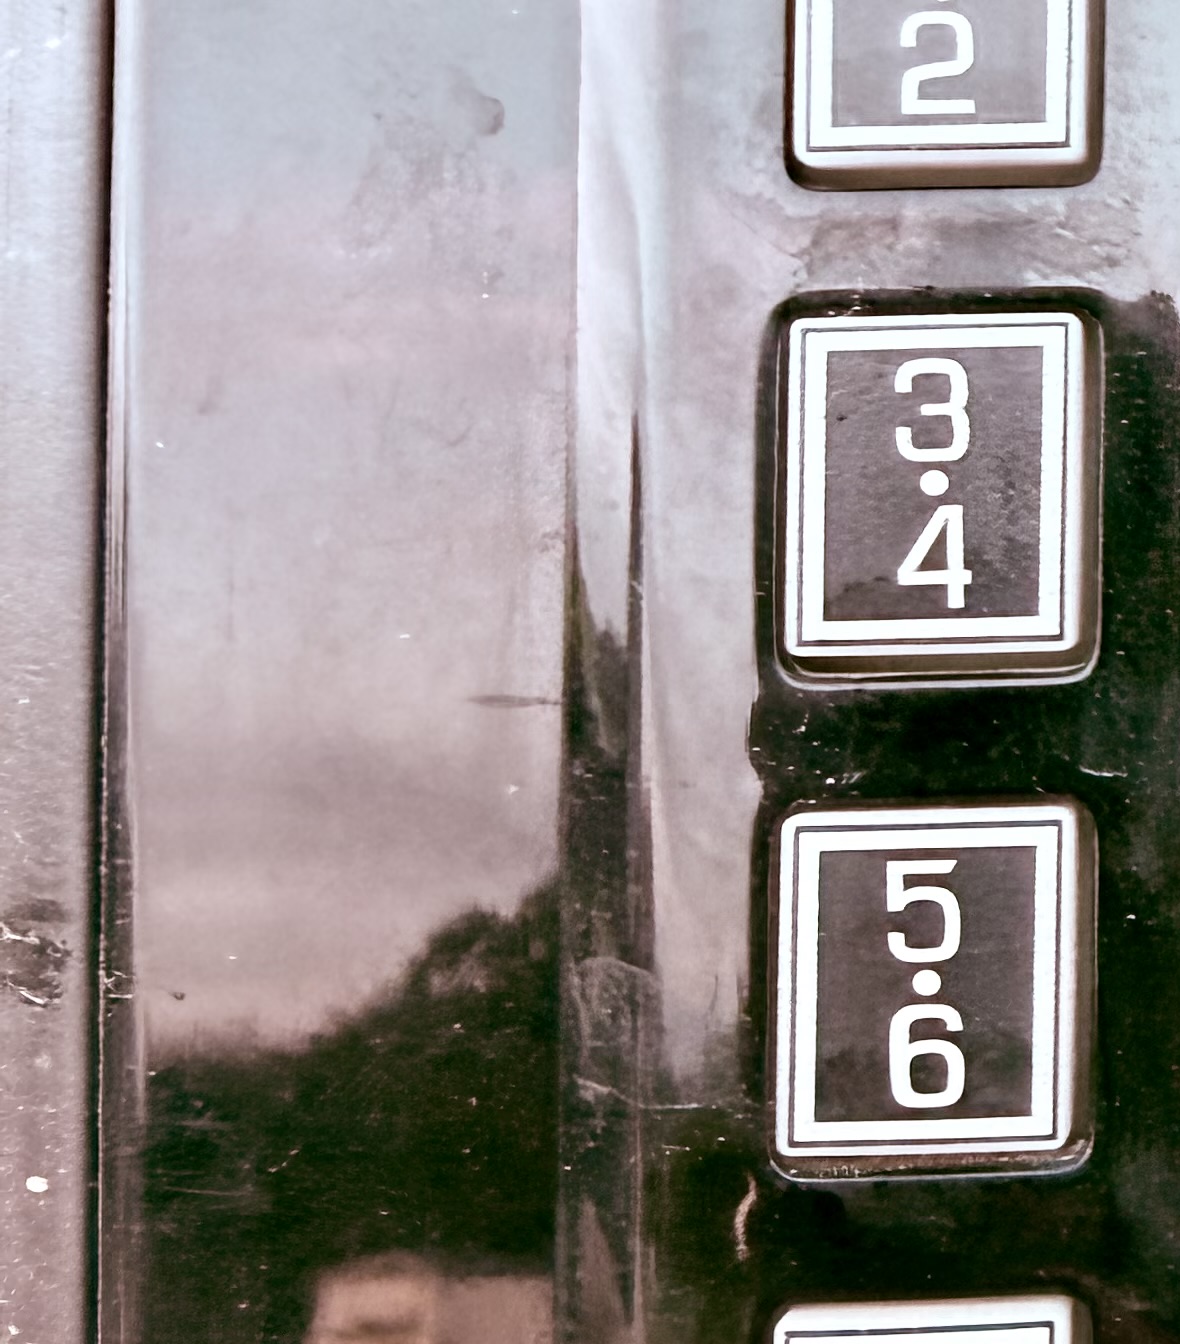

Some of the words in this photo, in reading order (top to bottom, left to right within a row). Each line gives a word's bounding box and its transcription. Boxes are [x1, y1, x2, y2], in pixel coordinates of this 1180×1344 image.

[900, 11, 975, 114] 2
[894, 358, 970, 462] 3
[897, 505, 972, 608] 4
[886, 860, 961, 962] 5
[889, 1004, 965, 1108] 6
